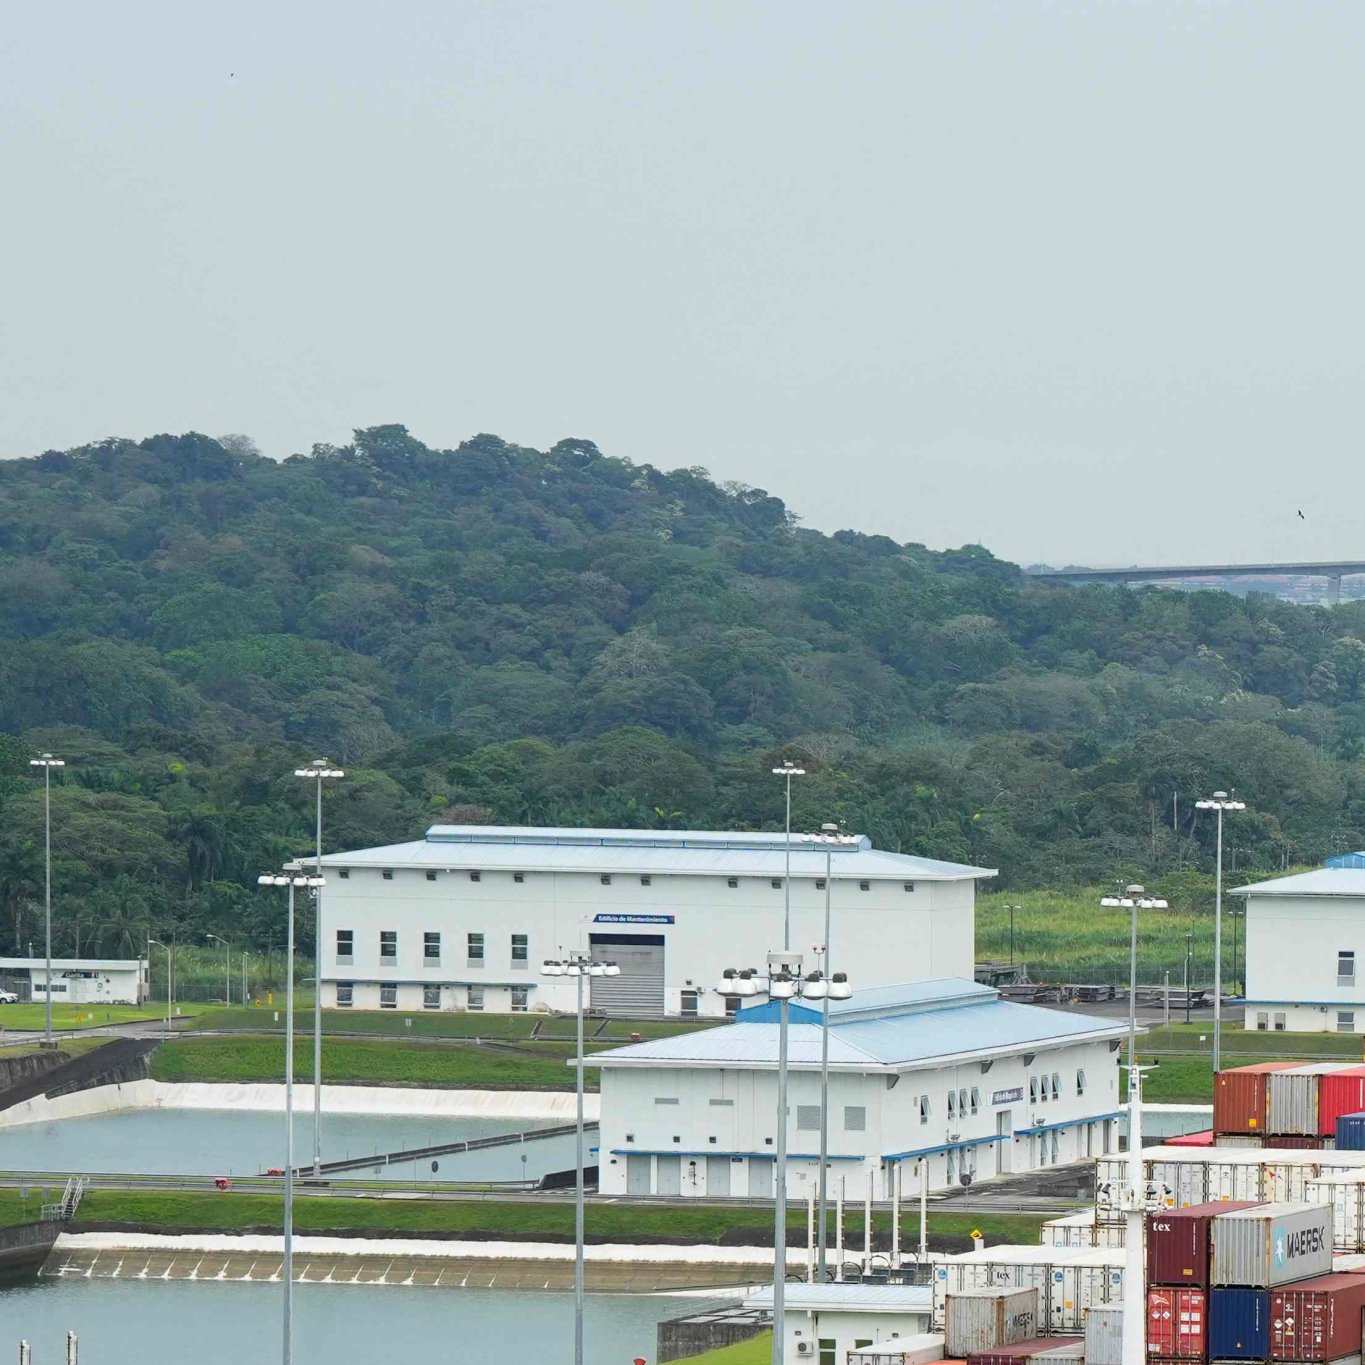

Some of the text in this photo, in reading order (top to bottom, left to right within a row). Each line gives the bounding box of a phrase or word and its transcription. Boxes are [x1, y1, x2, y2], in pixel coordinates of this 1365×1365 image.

[1152, 1221, 1171, 1232] tex
[1287, 1225, 1325, 1259] MAERSK
[996, 1271, 1010, 1280] tex
